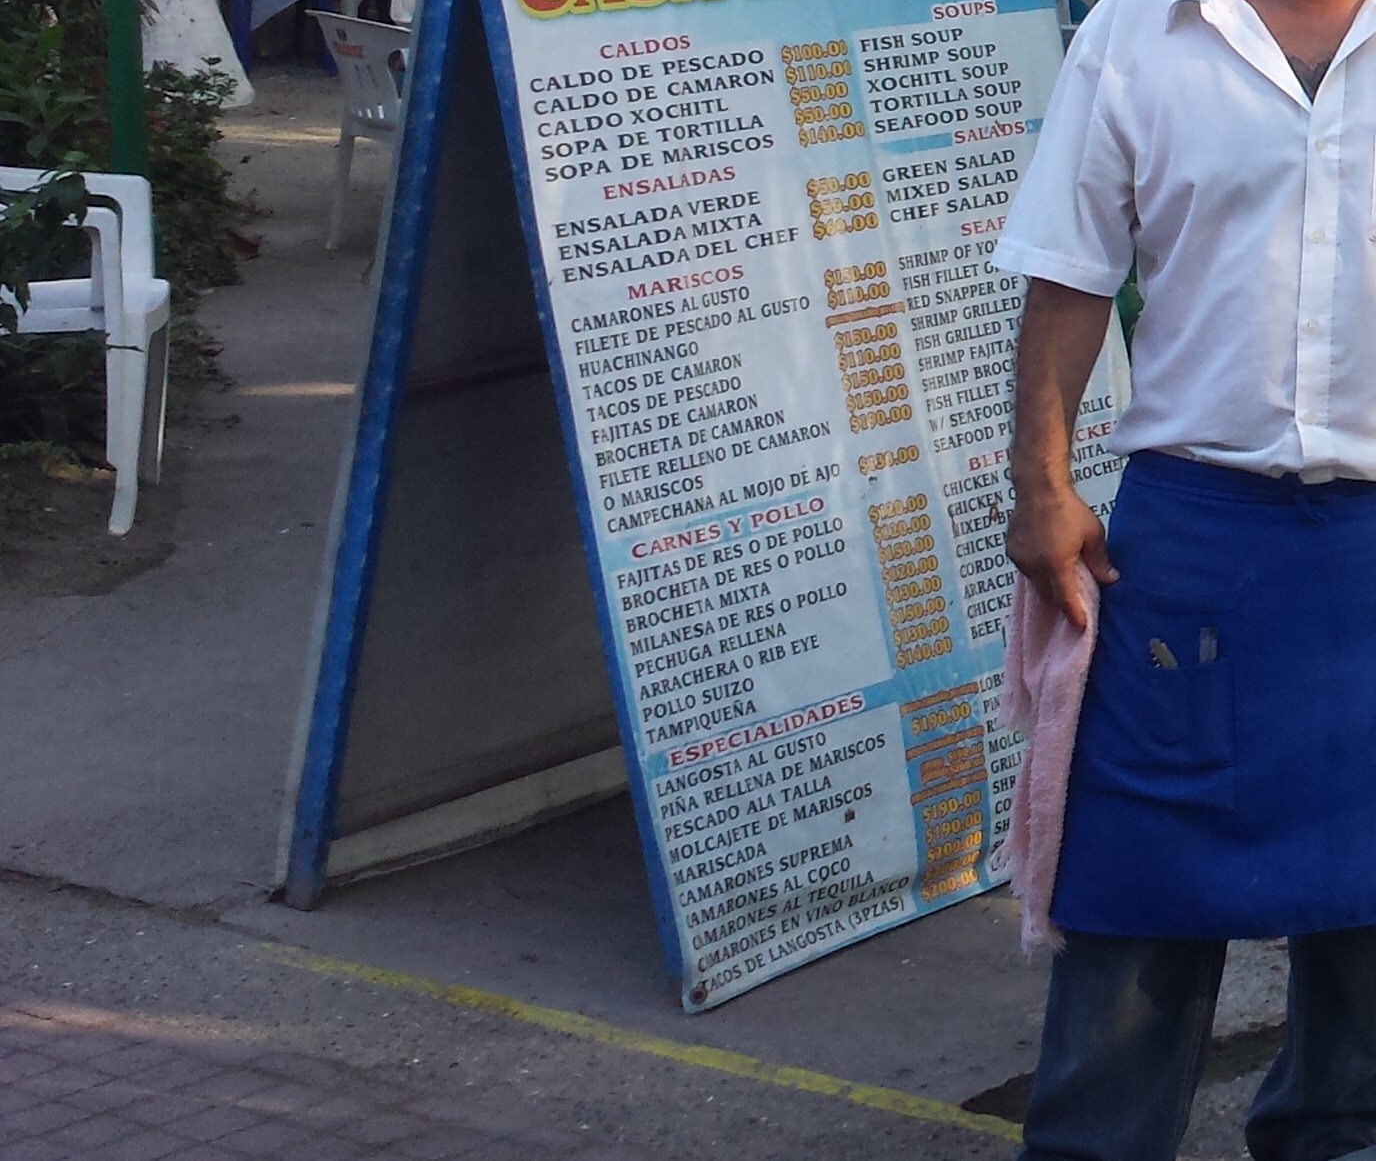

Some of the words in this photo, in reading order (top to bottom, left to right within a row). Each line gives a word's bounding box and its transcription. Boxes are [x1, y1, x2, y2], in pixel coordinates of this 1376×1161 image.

[932, 1, 996, 20] SOUPS
[600, 35, 691, 59] CALDOS
[860, 35, 905, 52] FISH
[911, 28, 964, 45] SOUP
[864, 51, 939, 72] SHRIMP
[947, 44, 996, 62] SOUP
[530, 69, 613, 92] CALDO
[623, 64, 654, 81] DE
[663, 50, 764, 75] PESCADO
[534, 91, 618, 115] CALDO
[627, 85, 657, 103] DE
[667, 70, 775, 96] CAMARON
[867, 71, 957, 94] XOCHITL
[962, 62, 1009, 80] SOUP
[538, 113, 623, 138] CALDO
[631, 98, 729, 125] XOCHITL
[870, 88, 968, 113] TORTILLA
[973, 80, 1022, 98] SOUP
[875, 108, 968, 134] SEAFOOD
[975, 100, 1023, 119] SOUP
[541, 138, 609, 160] SOPA
[618, 131, 649, 149] DE
[656, 114, 764, 142] TORTILLA
[954, 121, 1025, 144] SALADS
[545, 160, 612, 182] SOPA
[621, 153, 654, 171] DE
[663, 134, 774, 164] MARISCOS
[882, 160, 948, 183] GREEN
[955, 149, 1016, 170] SALAD
[602, 166, 736, 200] ENSALADAS
[886, 181, 950, 203] MIXED
[958, 169, 1018, 191] SALAD
[553, 204, 684, 238] ENSALADA
[688, 191, 761, 216] VERDE
[890, 202, 940, 223] CHEF
[947, 191, 1009, 213] SALAD
[558, 226, 687, 261] ENSALADA
[692, 213, 762, 238] MIXTA
[562, 248, 691, 283] ENSALADA
[695, 240, 737, 259] DEL
[745, 227, 799, 249] CHEF
[627, 265, 744, 300] MARISCOS
[907, 294, 931, 311] RED
[936, 282, 995, 305] SNAPPER
[571, 300, 675, 333] CAMARONES
[681, 295, 699, 313] AL
[702, 286, 750, 308] GUSTO
[575, 332, 631, 356] FILETE
[636, 325, 660, 341] DE
[665, 314, 732, 338] PESCADO
[737, 306, 757, 322] AL
[761, 296, 810, 318] GUSTO
[579, 341, 699, 378] HUACHINANGO
[582, 376, 638, 400] TACOS
[643, 370, 665, 386] DE
[670, 353, 743, 381] CAMARON
[587, 399, 640, 422] TACOS
[646, 392, 668, 408] DE
[675, 376, 742, 404] PESCADO
[591, 419, 653, 445] FAJITAS
[658, 412, 681, 429] DE
[687, 394, 758, 423] CAMARON
[595, 437, 682, 467] BROCHETA
[688, 429, 709, 445] DE
[711, 410, 785, 439] CAMARON
[599, 466, 651, 489] FILETE
[657, 447, 726, 476] RELLENO
[732, 440, 752, 457] DE
[758, 421, 831, 451] CAMARON
[607, 495, 715, 534] CAMPECHANA
[719, 489, 738, 506] AL
[743, 477, 785, 499] MOJO
[790, 471, 811, 487] DE
[816, 463, 840, 483] AJO
[631, 524, 721, 559] CARNES
[728, 518, 742, 534] Y
[751, 497, 825, 529] POLLO
[617, 561, 681, 589] FAJITAS
[685, 552, 707, 571] DE
[714, 544, 743, 564] RES
[750, 539, 760, 554] O
[767, 535, 788, 551] DE
[792, 517, 843, 543] POLLO
[622, 577, 709, 611] BROCHETA
[715, 569, 737, 586] DE
[742, 558, 772, 579] RES
[777, 554, 789, 569] O
[795, 539, 845, 564] POLLO
[626, 599, 714, 634] BROCHETA
[720, 581, 771, 607] MIXTA
[630, 620, 715, 656] MILANESA
[719, 613, 739, 631] DE
[746, 603, 775, 624] RES
[780, 598, 792, 612] O
[797, 582, 848, 608] POLLO
[634, 644, 713, 678] PECHUGA
[720, 622, 786, 654] RELLENA
[640, 661, 739, 700] ARRACHERA
[743, 655, 753, 669] O
[759, 648, 786, 665] RIB
[791, 635, 820, 655] EYE
[642, 694, 696, 722] POLLO
[702, 678, 754, 705] SUIZO
[647, 700, 756, 745] TAMPIQUEÑA
[670, 695, 863, 767] ESPECIALIDADES
[655, 759, 743, 797] LANGOSTA
[747, 751, 768, 769] AL
[775, 732, 827, 759] GUSTO
[660, 796, 700, 820] PIÑA
[705, 771, 776, 805] RELLENA
[782, 763, 803, 780] DE
[809, 734, 886, 771] MARISCOS
[665, 805, 740, 842] PESCADO
[781, 776, 832, 802] TALLA
[669, 821, 762, 864] MOLCAJETE
[768, 812, 789, 831] DE
[794, 783, 873, 822] MARISCOS
[673, 843, 767, 885] MARISCADA
[780, 835, 854, 871] SUPREMA
[784, 874, 803, 893] AL
[808, 857, 850, 882] COCO
[808, 871, 874, 902] TEQUILA
[771, 919, 846, 963] LANGOSTA
